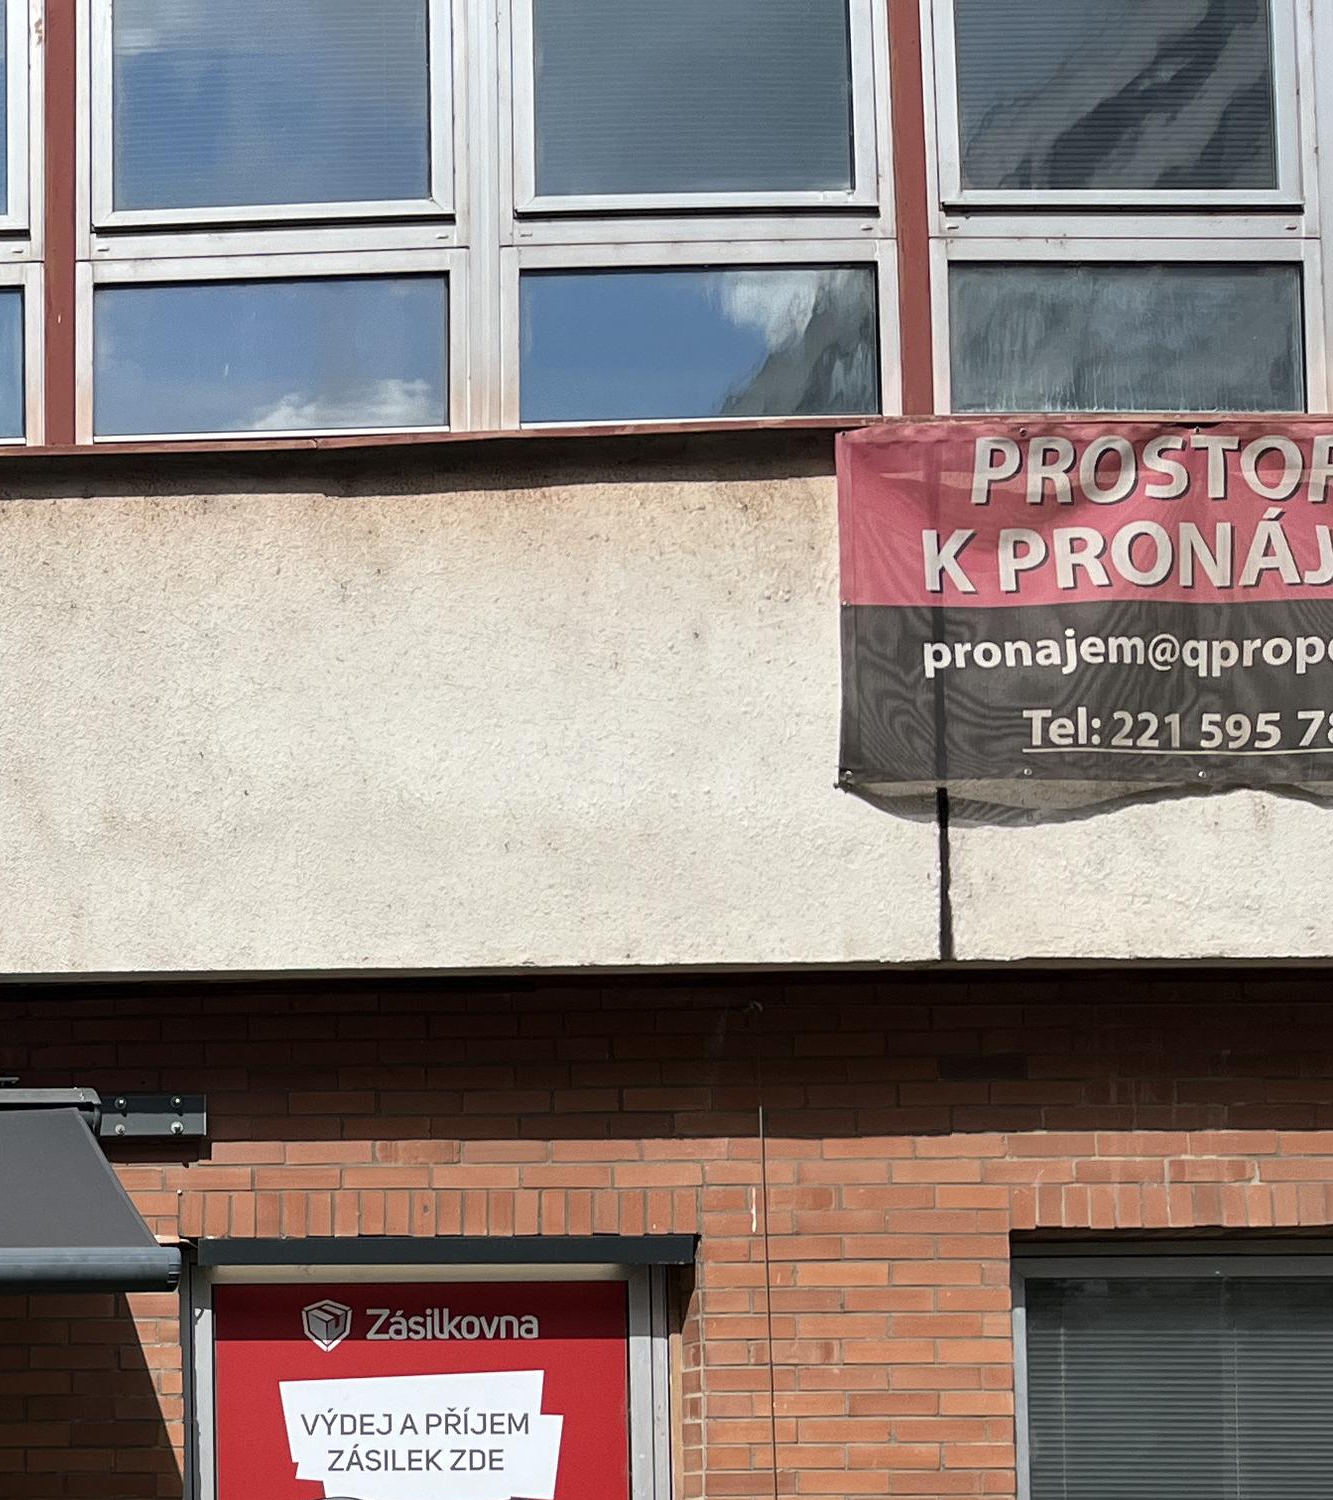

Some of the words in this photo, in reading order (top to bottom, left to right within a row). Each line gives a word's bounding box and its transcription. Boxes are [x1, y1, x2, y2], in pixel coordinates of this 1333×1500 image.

[922, 529, 978, 594] K
[923, 628, 1333, 679] pronajem@qprop
[1022, 706, 1102, 747] Tel:
[1111, 711, 1181, 748] 221
[1200, 711, 1282, 749] 595
[365, 1308, 539, 1340] Zásilkovna
[300, 1407, 393, 1436] VÝDEJ
[399, 1413, 419, 1436] A
[425, 1407, 530, 1436] PŘÍJEM
[327, 1443, 443, 1472] ZÁSILEK
[450, 1448, 504, 1472] ZDE
